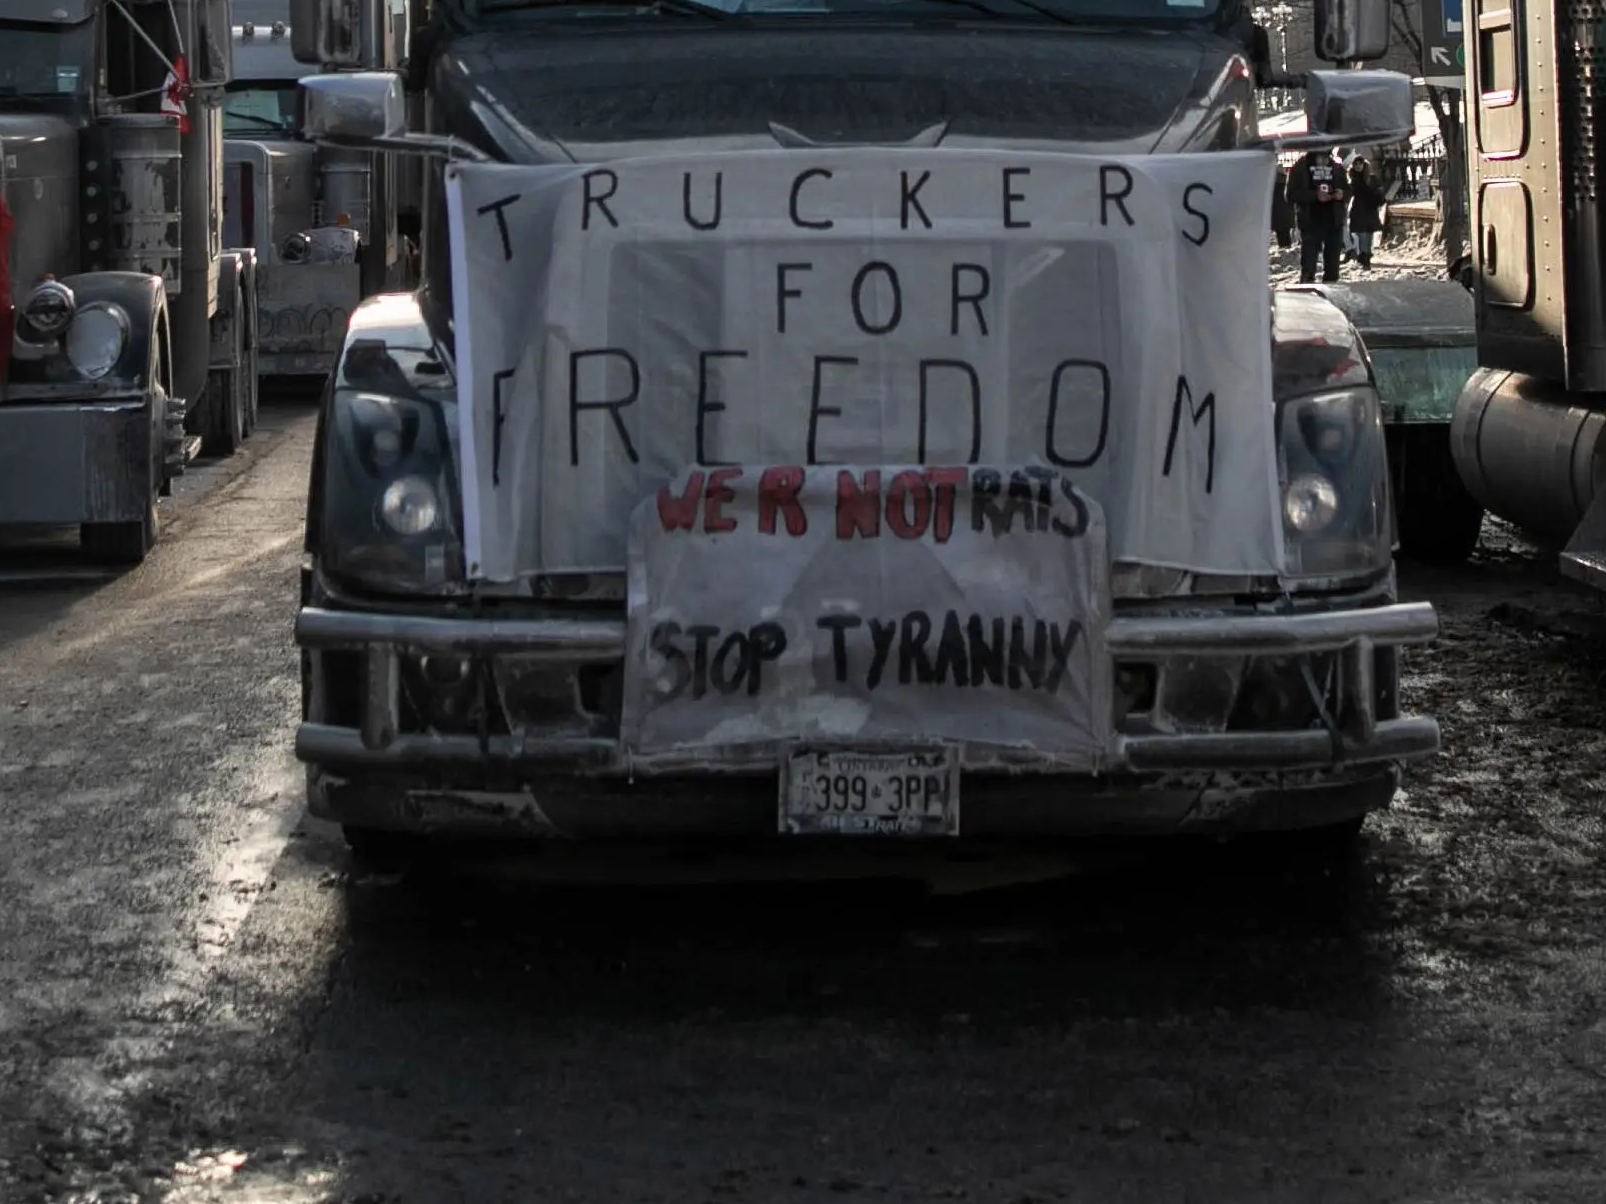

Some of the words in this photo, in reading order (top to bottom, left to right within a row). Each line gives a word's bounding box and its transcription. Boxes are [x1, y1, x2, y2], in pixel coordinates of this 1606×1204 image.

[476, 167, 1214, 261] TRUCKERS
[775, 260, 992, 336] FOR
[493, 348, 1217, 495] FREEDOM
[656, 467, 744, 534] WE
[757, 465, 809, 537] R
[835, 467, 969, 544] NOT
[970, 465, 1091, 539] RATS
[649, 620, 788, 701] STOP
[815, 608, 1085, 694] TYRANNY
[815, 774, 867, 812] 399
